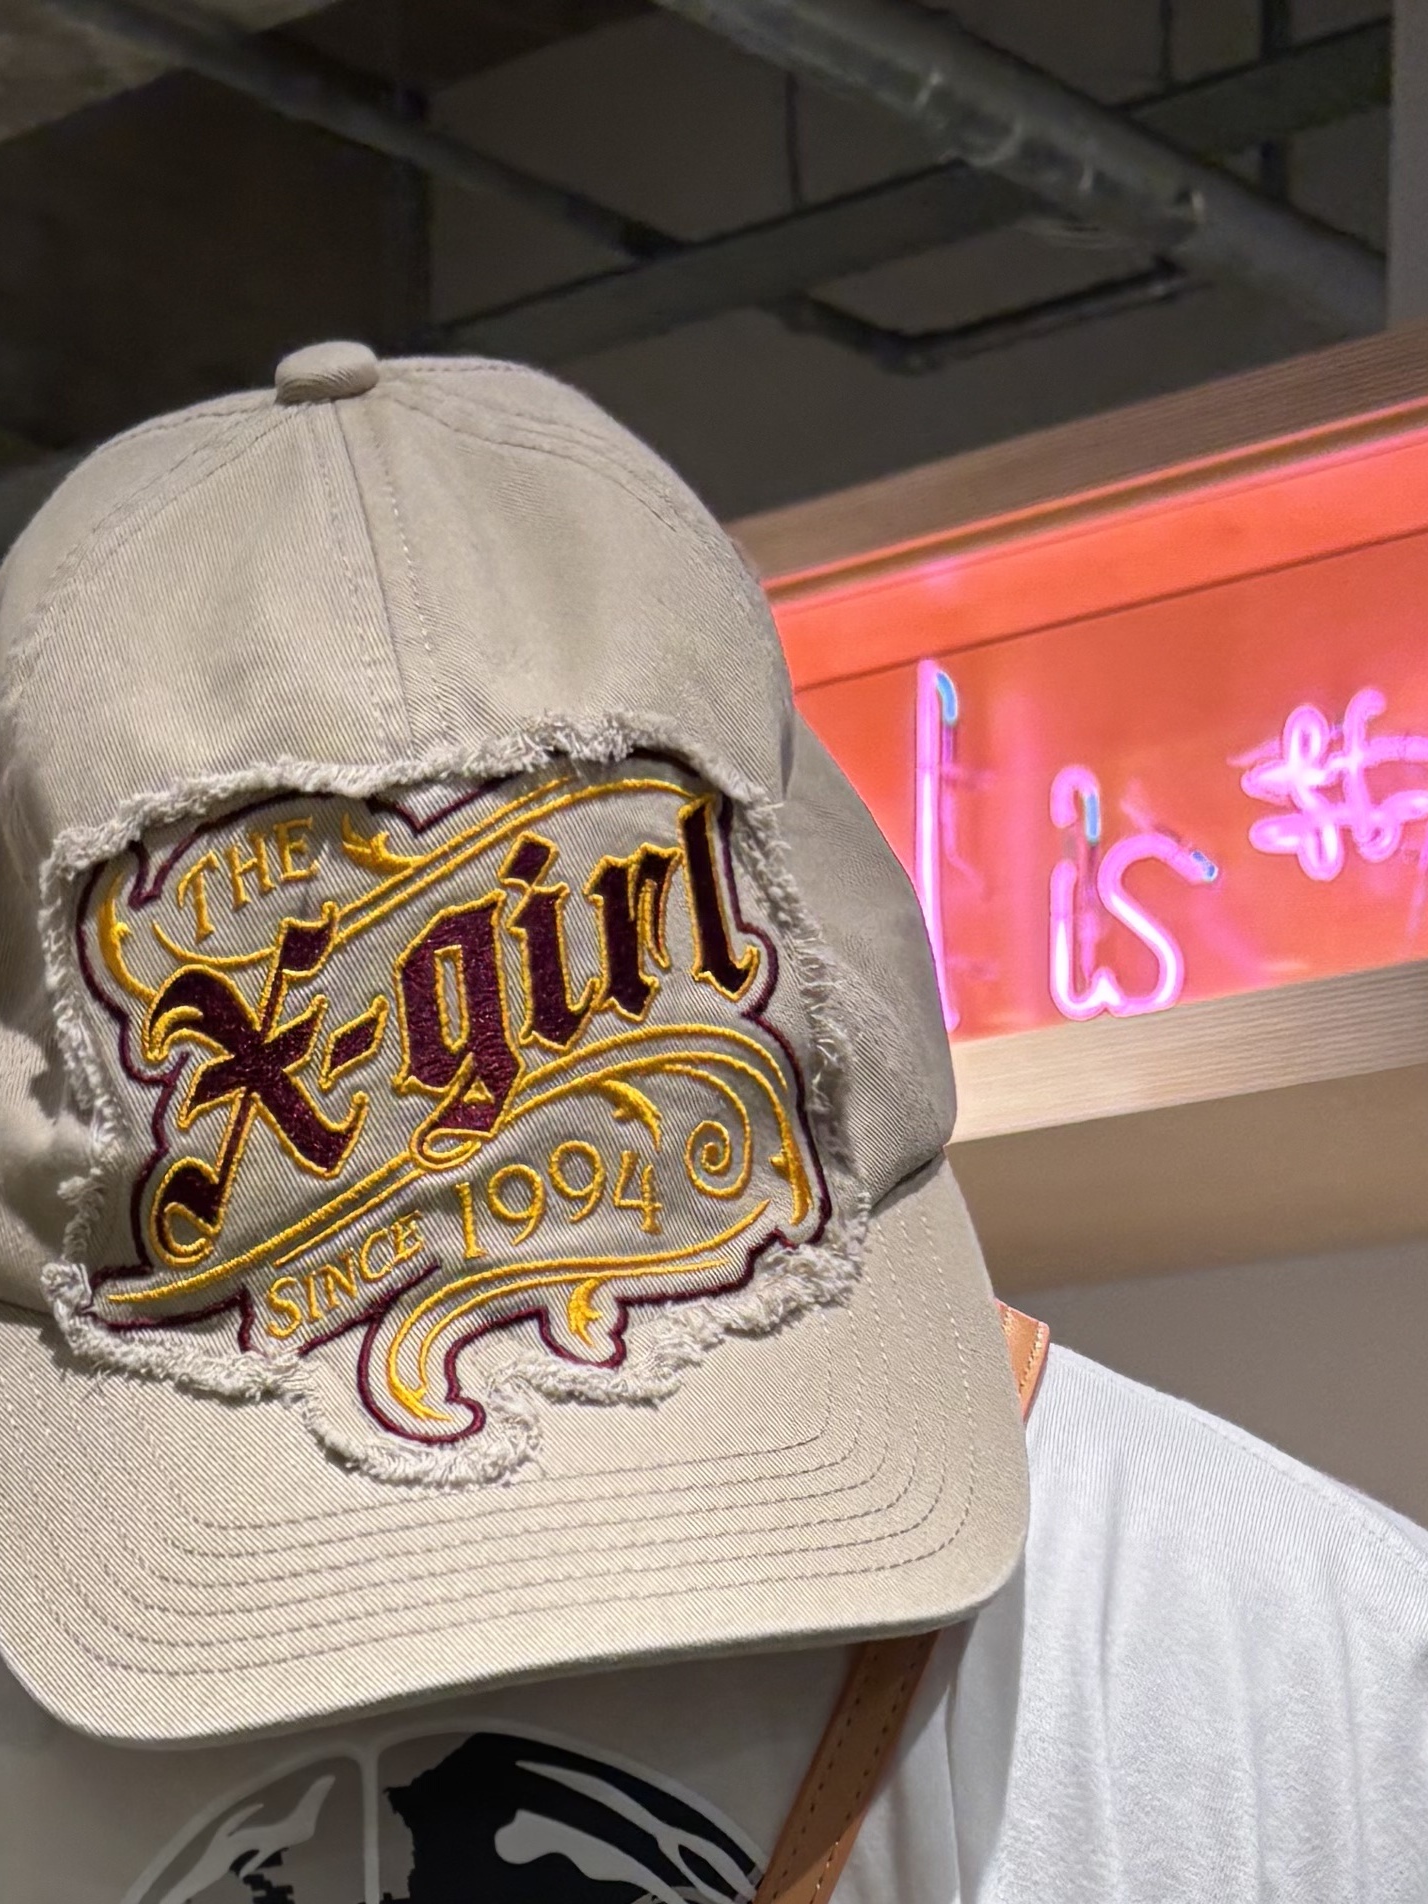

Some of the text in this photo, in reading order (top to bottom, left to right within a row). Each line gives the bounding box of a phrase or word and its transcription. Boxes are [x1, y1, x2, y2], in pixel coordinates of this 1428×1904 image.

[176, 815, 320, 942] THE
[1049, 765, 1220, 1022] is
[144, 800, 762, 1264] X-girl
[265, 1139, 664, 1340] SINCE 1994
